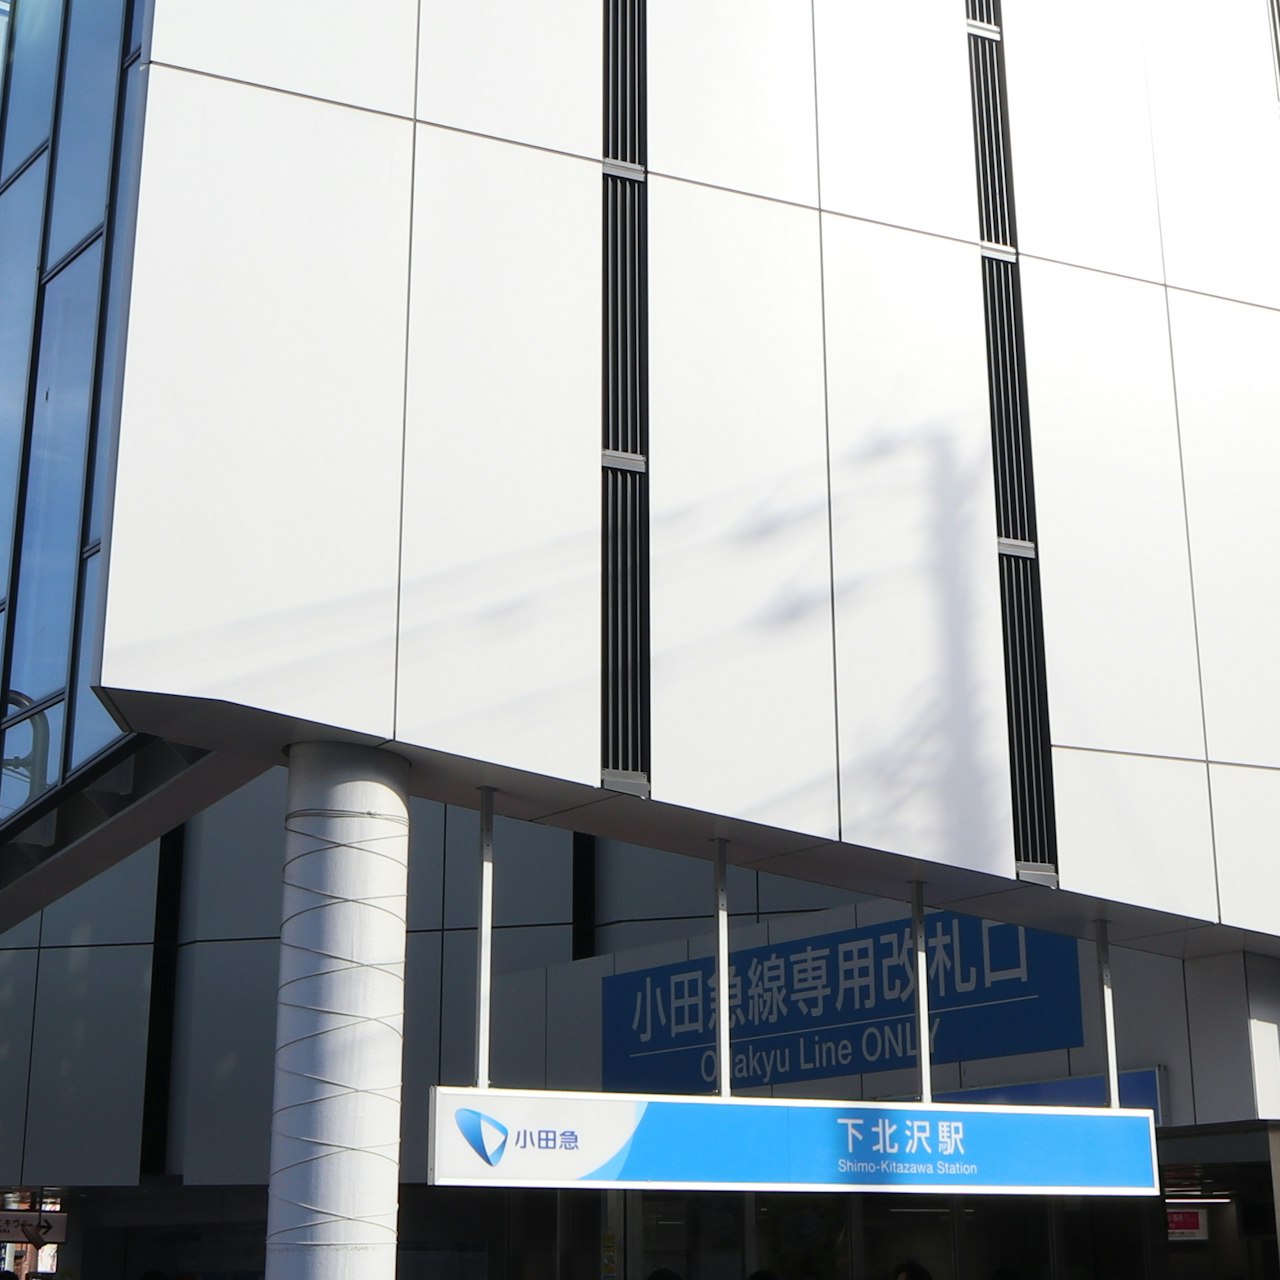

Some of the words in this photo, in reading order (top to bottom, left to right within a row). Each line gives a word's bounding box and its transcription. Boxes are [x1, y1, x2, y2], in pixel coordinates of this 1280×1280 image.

[631, 919, 1029, 1042] 小田急線専用改札口
[700, 1044, 790, 1083] Oakyu
[799, 1034, 852, 1069] Line
[514, 1129, 579, 1150] 小田急
[837, 1118, 965, 1155] 下北沢駅
[838, 1158, 934, 1174] Shimo-Kitazawa
[937, 1160, 977, 1175] Station
